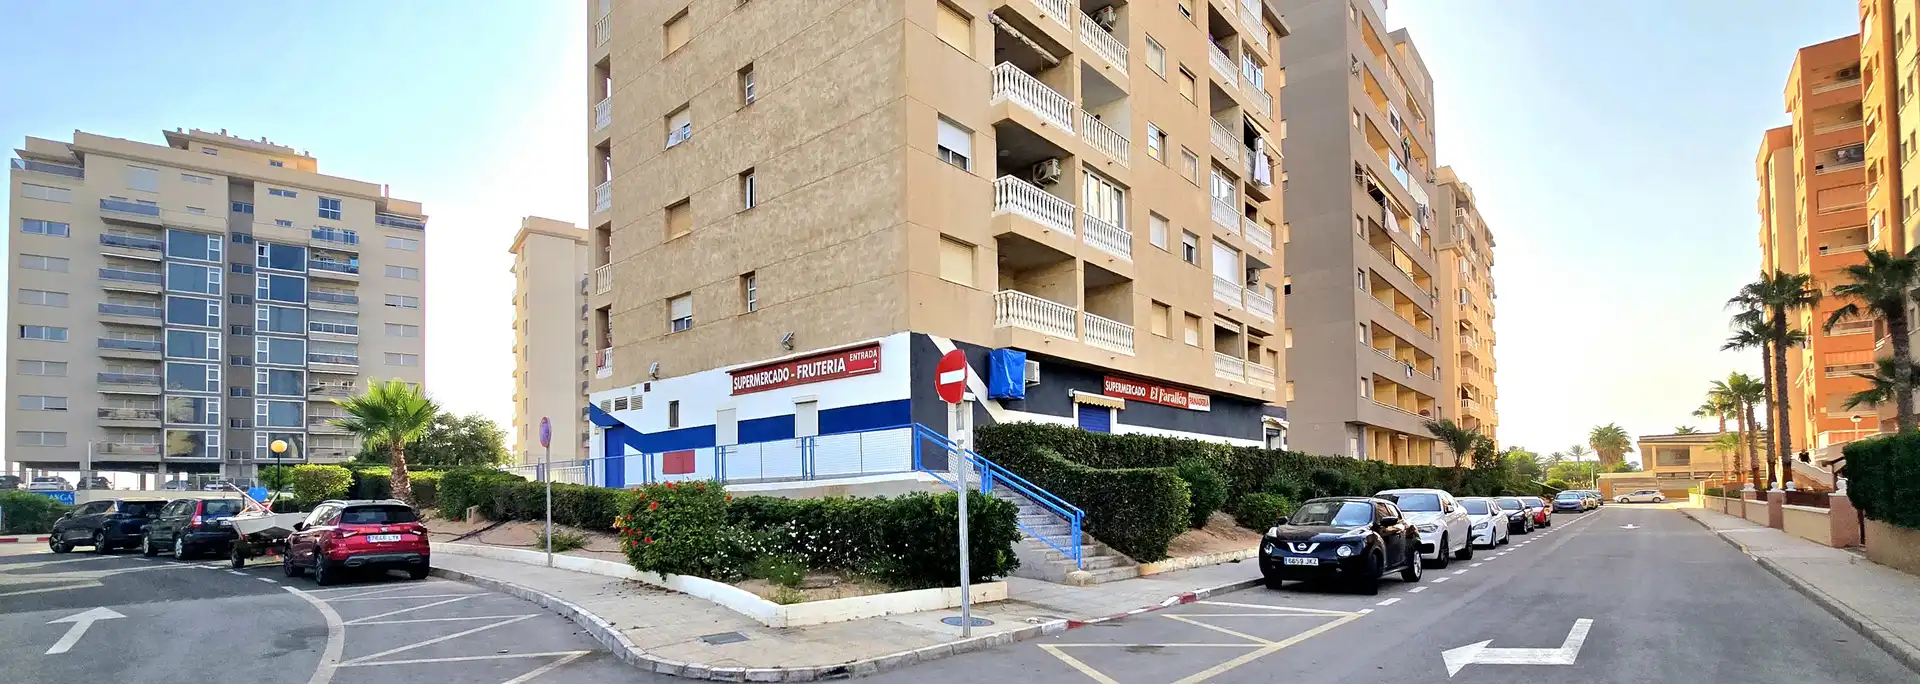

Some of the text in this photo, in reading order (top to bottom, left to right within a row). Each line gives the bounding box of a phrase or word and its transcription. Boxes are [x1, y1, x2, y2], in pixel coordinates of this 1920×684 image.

[850, 349, 878, 361] ENTRADA
[733, 367, 789, 390] SUPERMERCADO
[796, 357, 846, 379] FRUTERIA
[1105, 380, 1146, 397] SUPERMERCADO
[1150, 386, 1159, 400] El
[48, 493, 73, 501] ANGA
